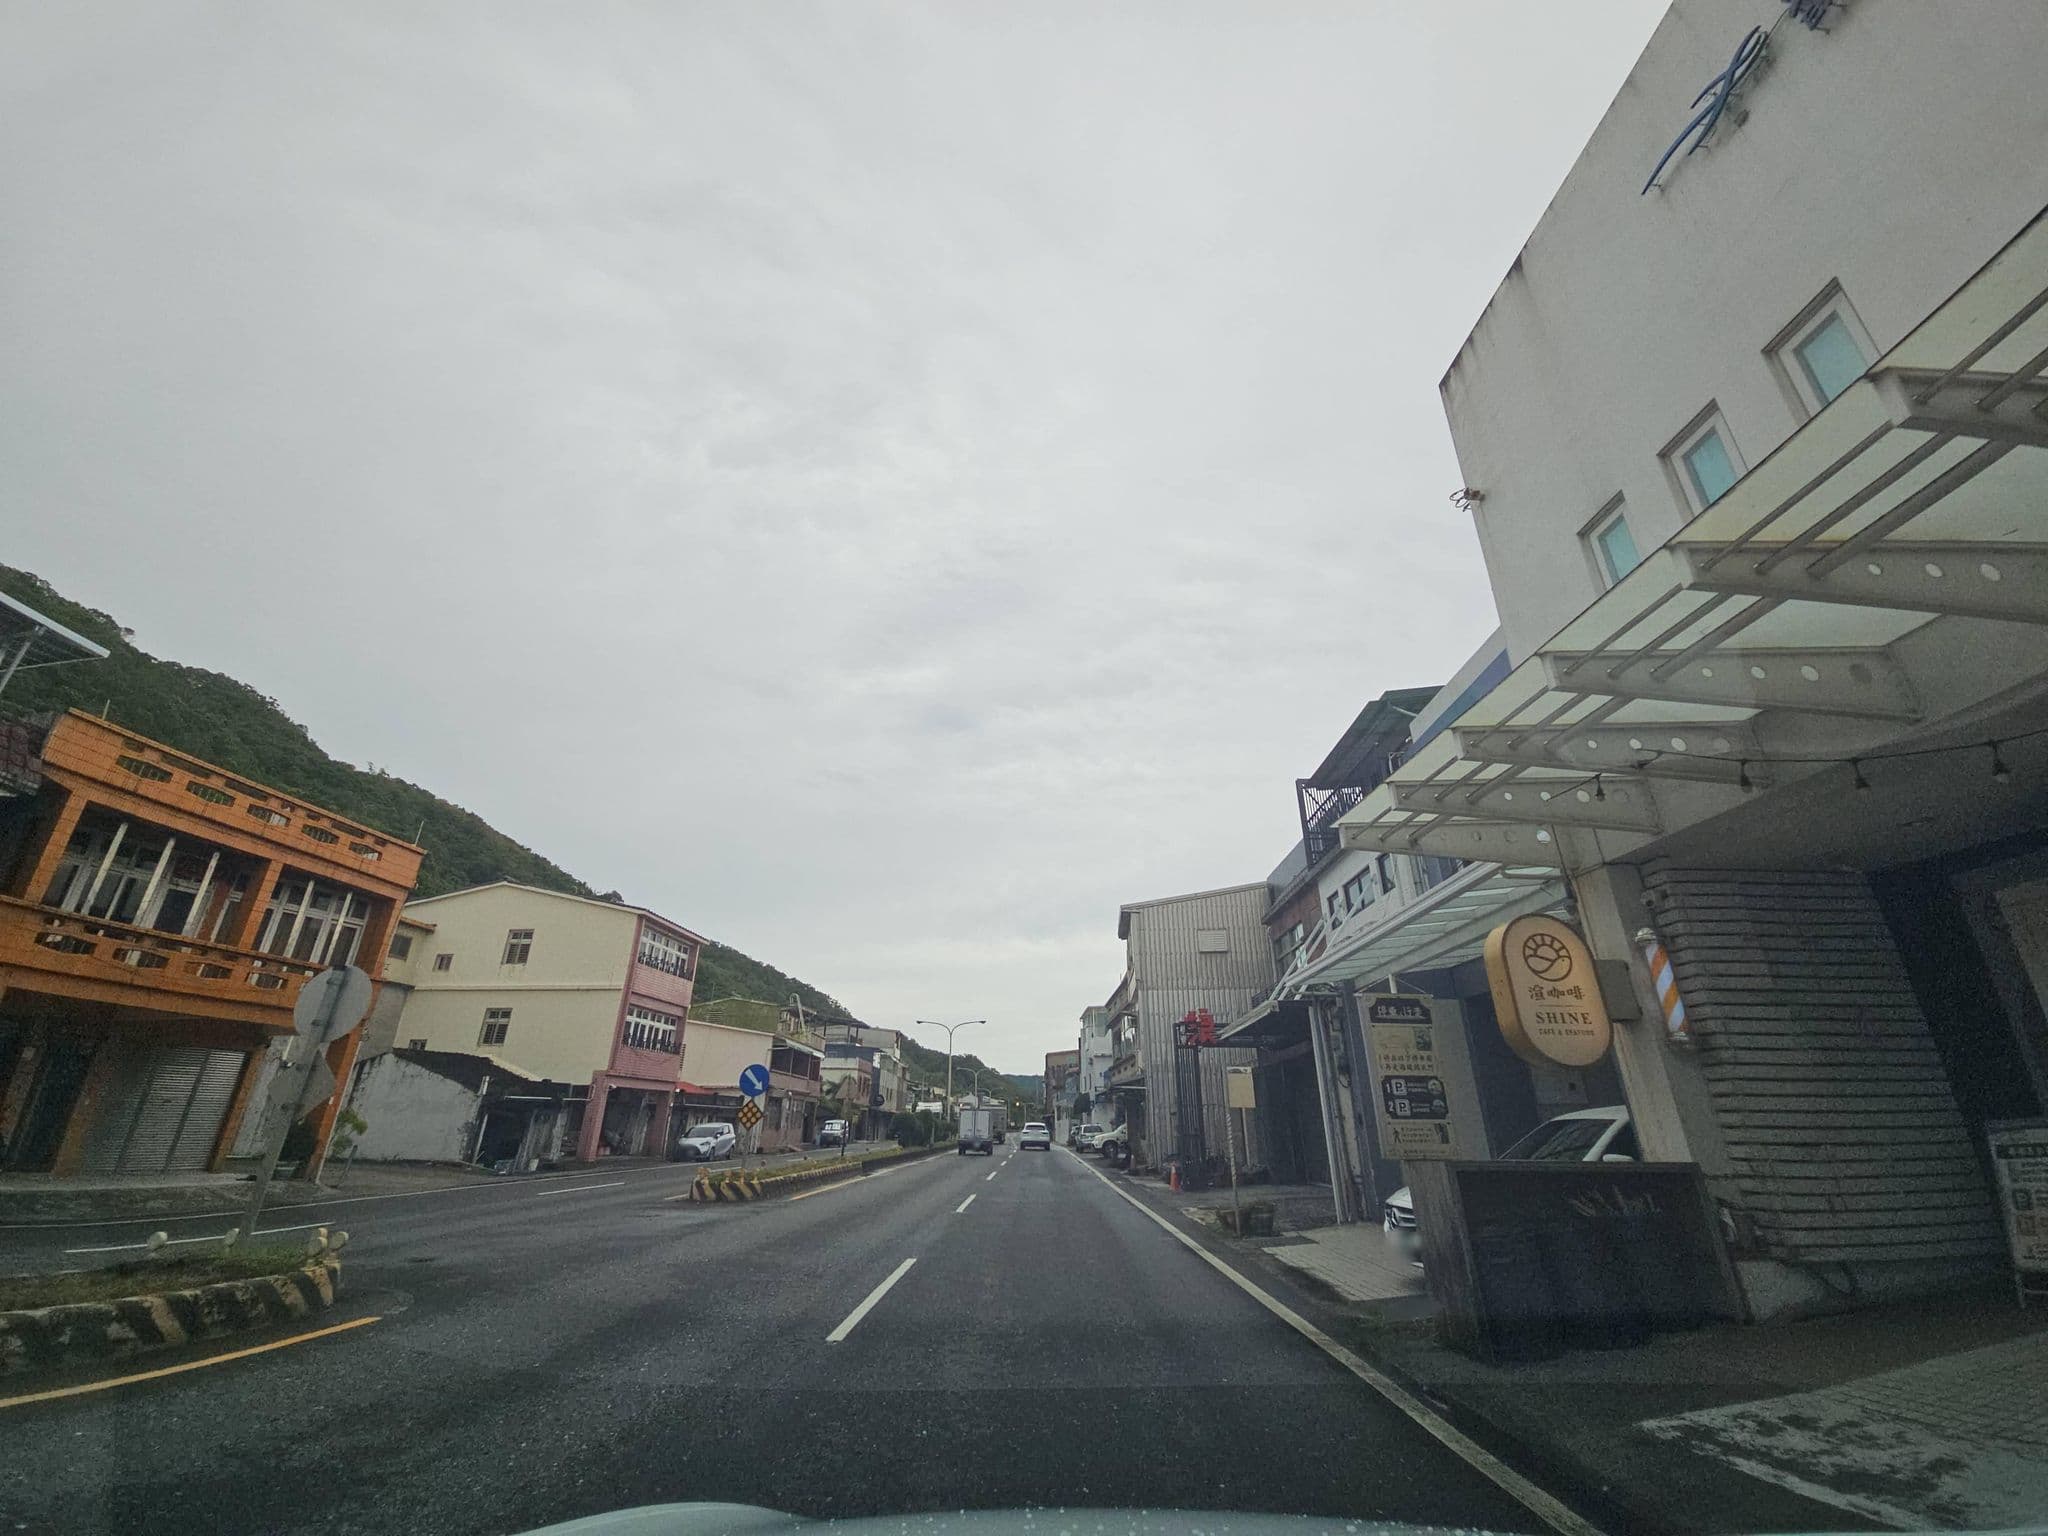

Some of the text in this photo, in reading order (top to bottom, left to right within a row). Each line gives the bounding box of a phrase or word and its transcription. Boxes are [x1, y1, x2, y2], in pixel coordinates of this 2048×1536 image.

[1536, 1012, 1592, 1025] SHINE
[1395, 1082, 1403, 1093] P
[1388, 1101, 1394, 1112] 2
[1399, 1102, 1407, 1113] P
